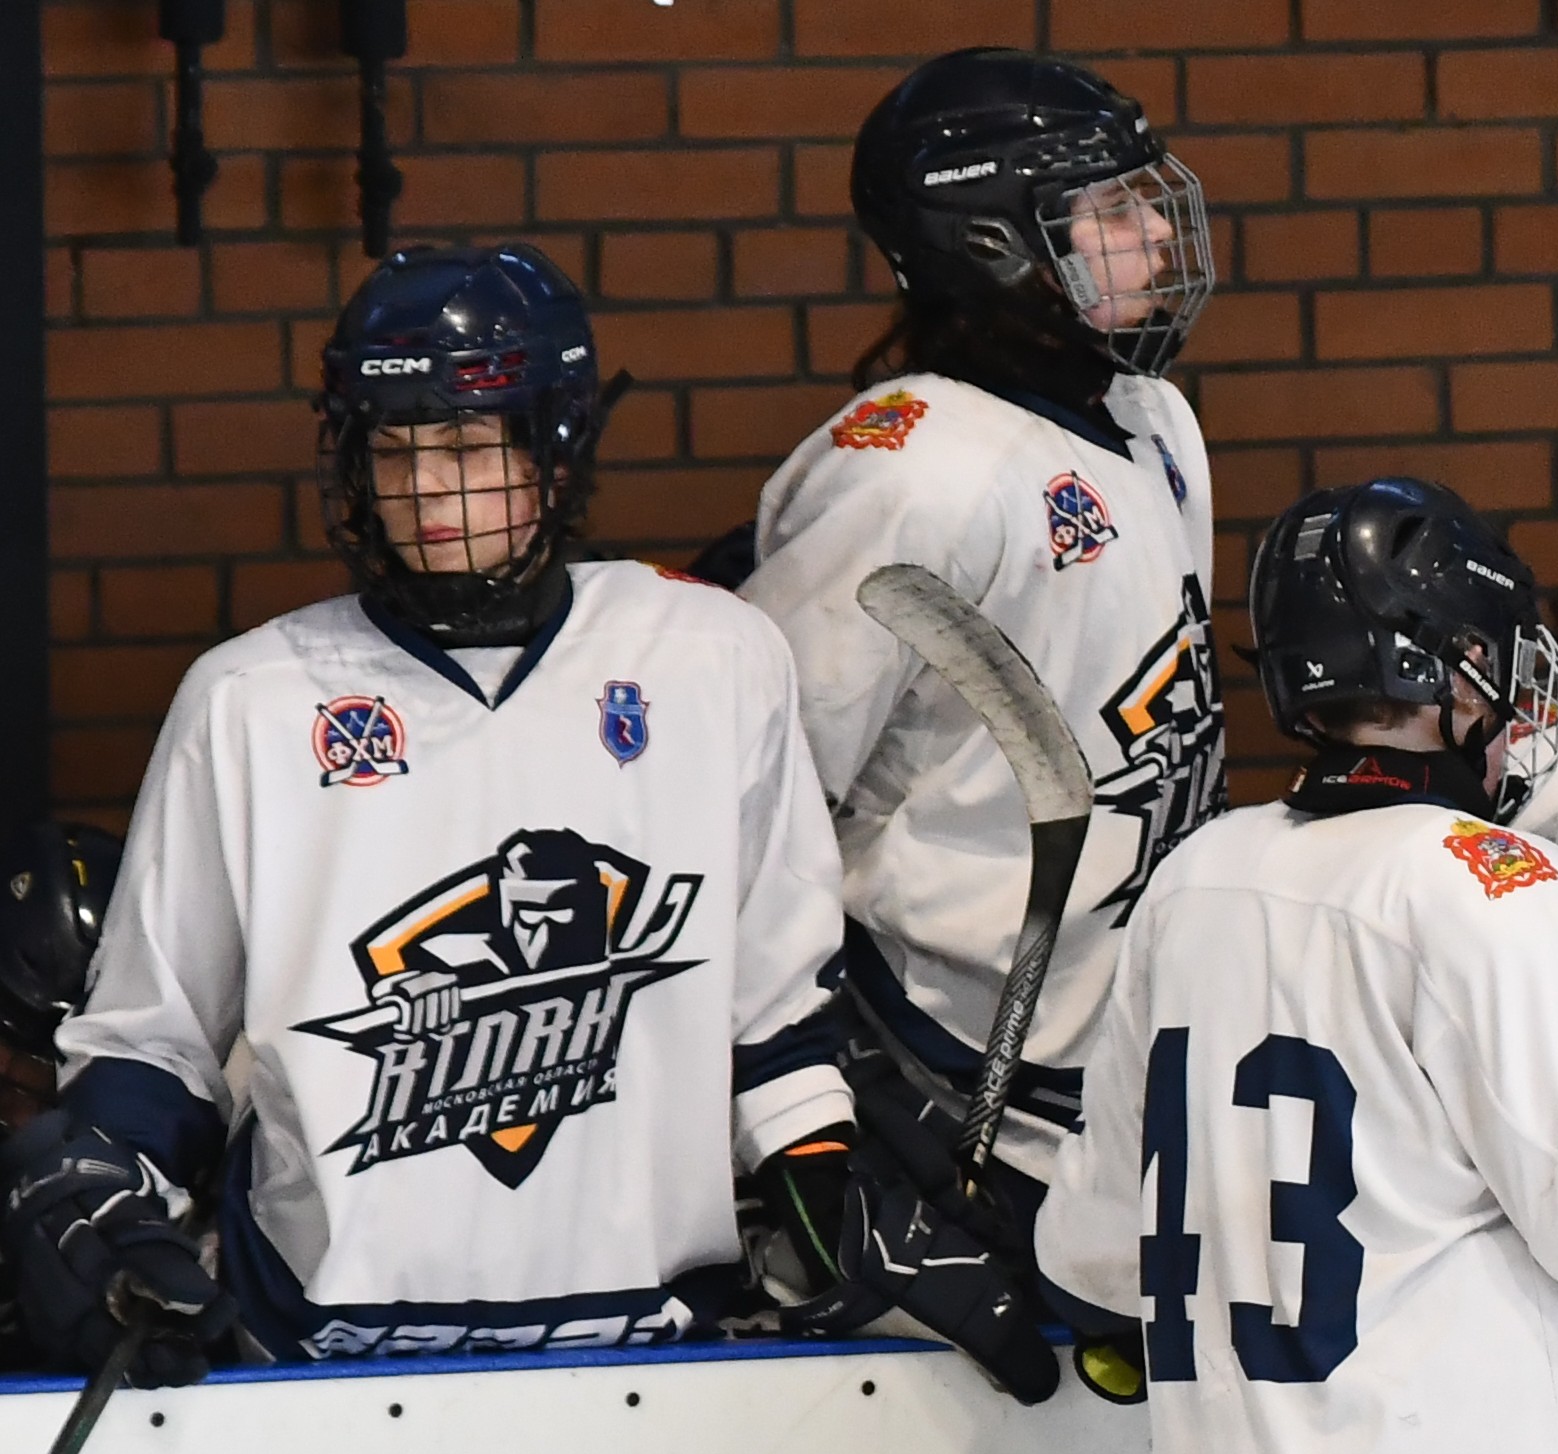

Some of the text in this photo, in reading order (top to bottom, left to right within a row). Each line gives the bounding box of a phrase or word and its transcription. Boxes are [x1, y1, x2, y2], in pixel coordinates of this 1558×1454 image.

[923, 160, 998, 187] BAUER
[360, 356, 433, 376] CCM
[1465, 558, 1516, 592] BAUER
[1458, 658, 1501, 702] BAUER
[326, 733, 395, 765] ФХМ
[361, 1066, 619, 1164] АКАДЕМИЯ
